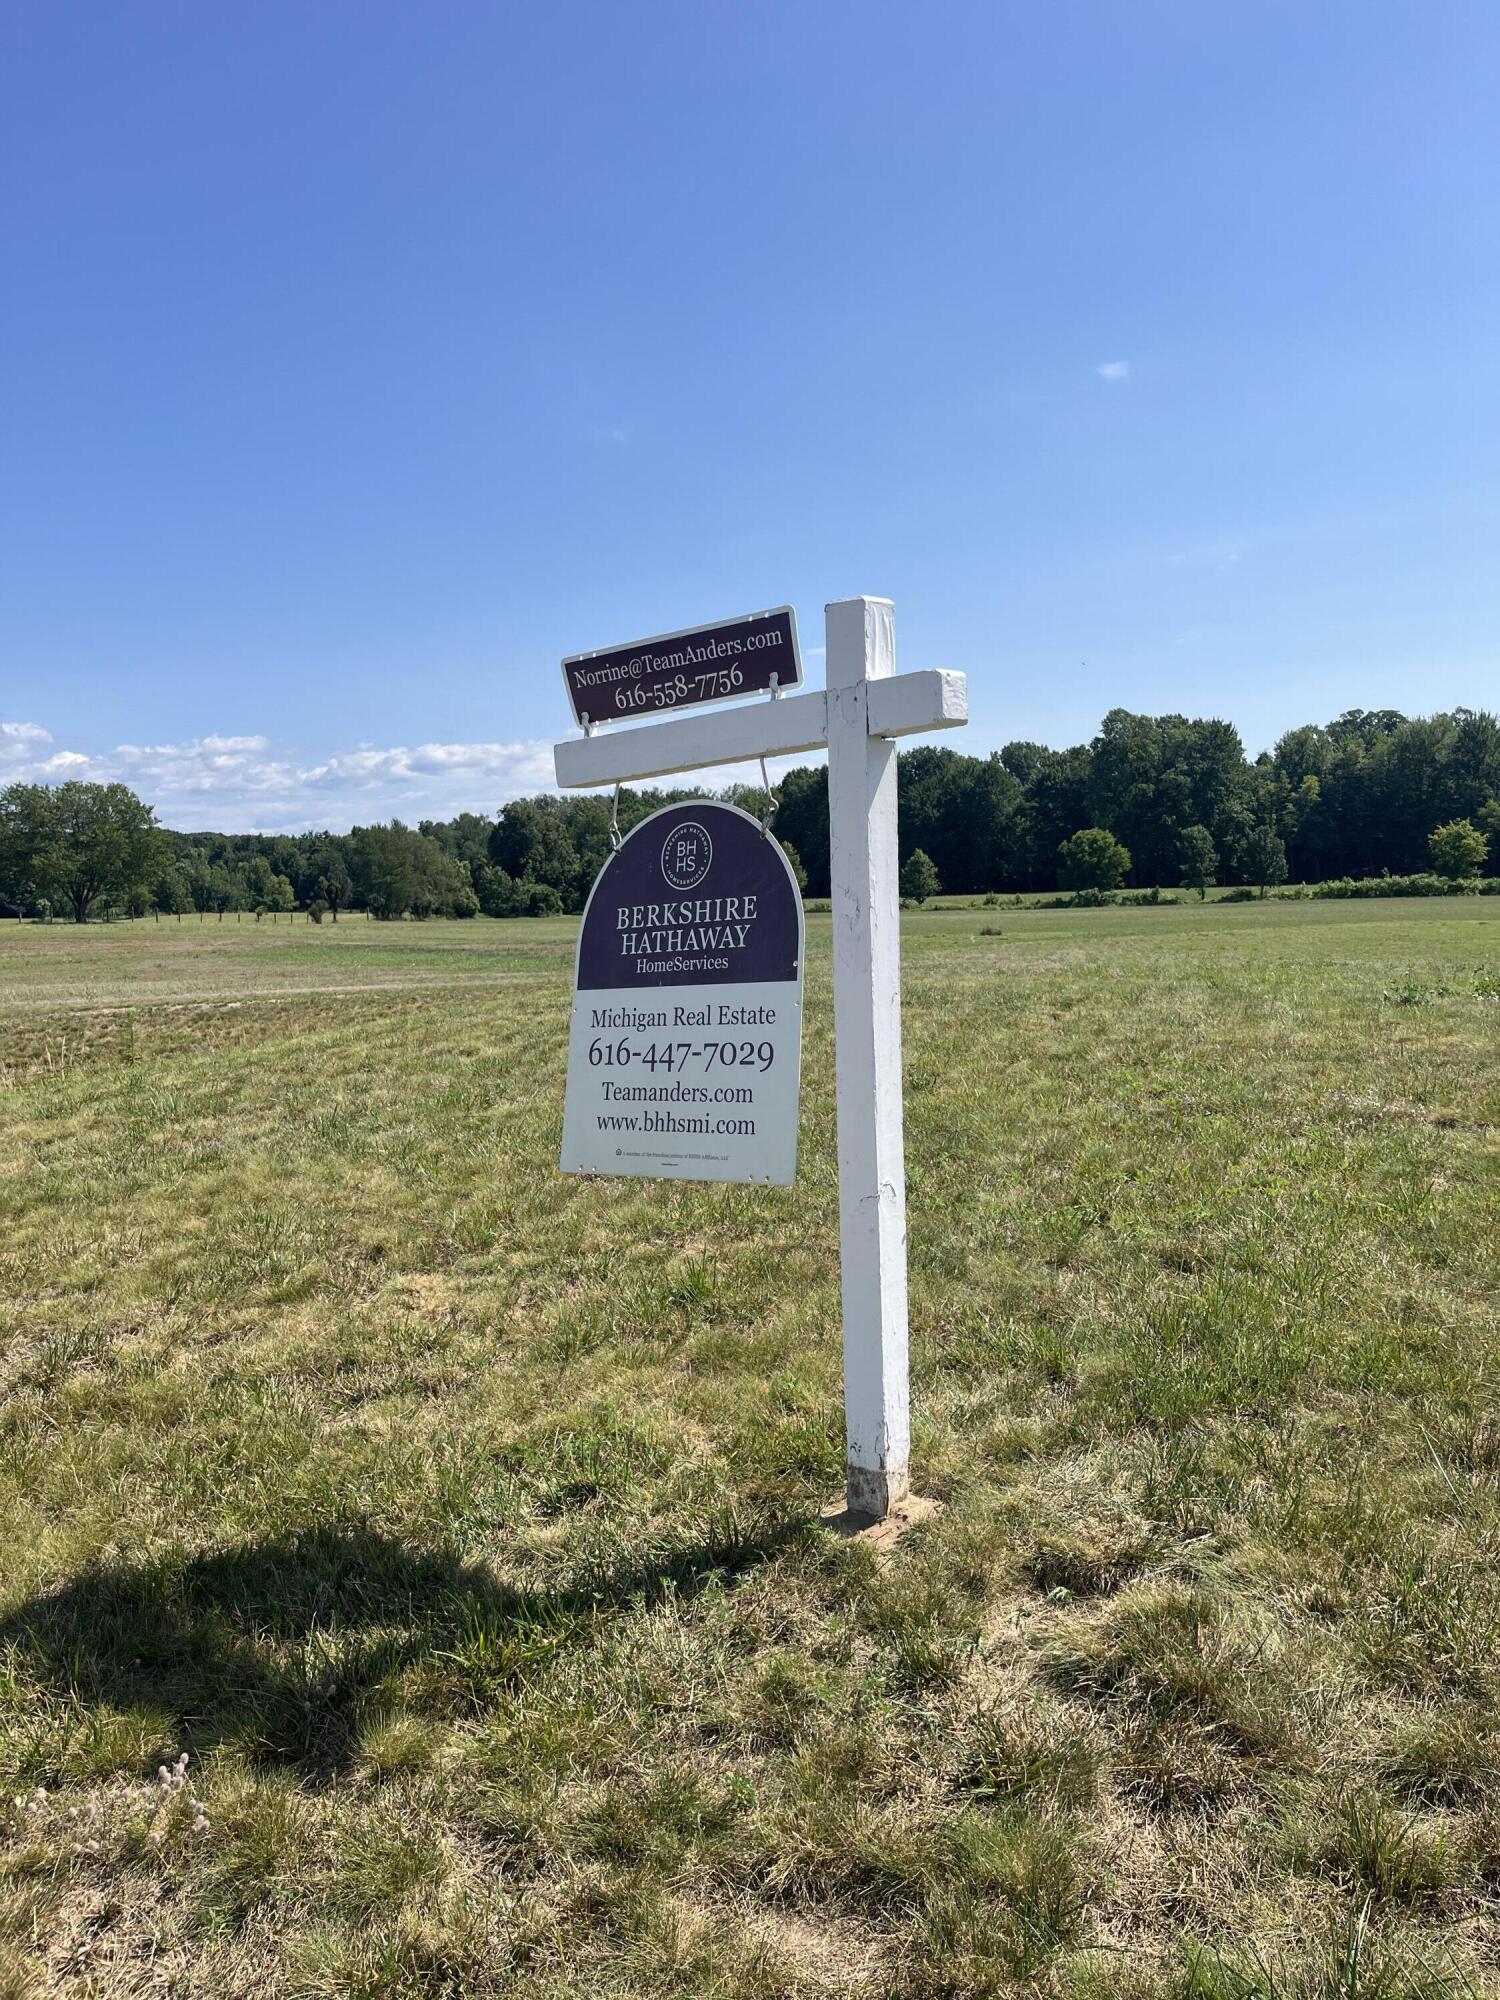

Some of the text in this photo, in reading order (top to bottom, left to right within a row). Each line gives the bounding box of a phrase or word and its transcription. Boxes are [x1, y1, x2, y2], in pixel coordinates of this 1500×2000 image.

[574, 629, 783, 688] Norrine@TeamAnders.com
[615, 662, 743, 709] 616-558-7756
[677, 840, 697, 856] BH
[676, 856, 696, 872] HS
[616, 895, 757, 930] BERKSHIRE
[620, 924, 751, 955] HATHAWAY
[636, 955, 729, 973] HomeServices
[590, 1005, 776, 1032] Michigan Real Estate
[588, 1037, 774, 1072] 616-447-7029
[602, 1081, 754, 1103] Teamanders.com
[597, 1111, 756, 1135] www.bhhsmi.com
